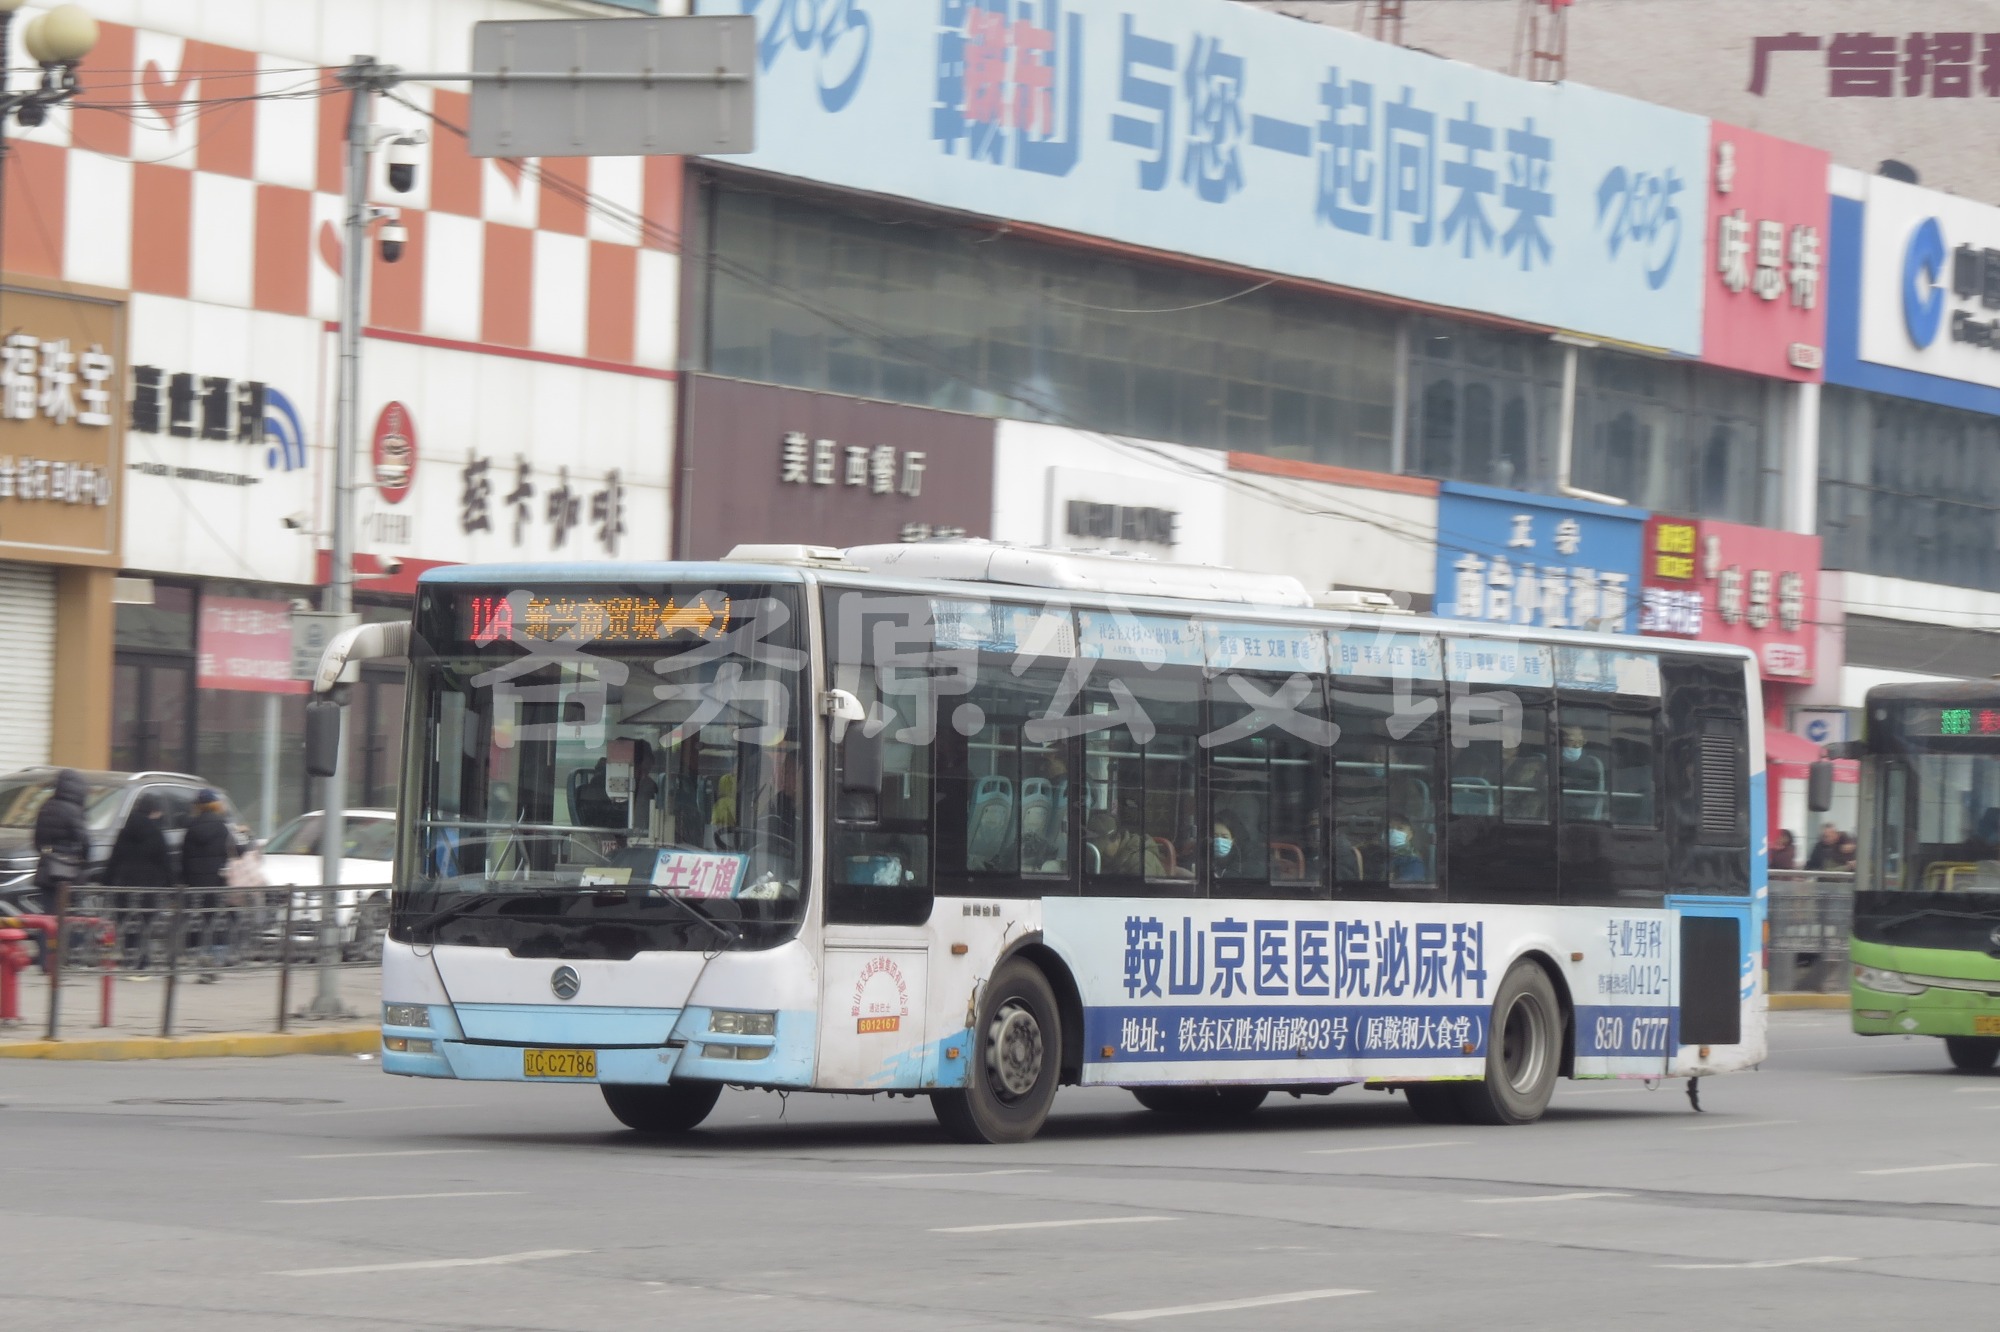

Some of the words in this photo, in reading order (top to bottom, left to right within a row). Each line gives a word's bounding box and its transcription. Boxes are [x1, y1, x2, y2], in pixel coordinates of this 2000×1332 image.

[470, 598, 513, 640] 11A
[1244, 637, 1262, 656] 民主
[662, 855, 739, 898] 大红旗
[1123, 915, 1488, 999] 鞍山京医医院泌尿科
[1607, 920, 1663, 958] 专业男科
[1594, 1016, 1623, 1050] 850
[1631, 1017, 1669, 1050] 6777
